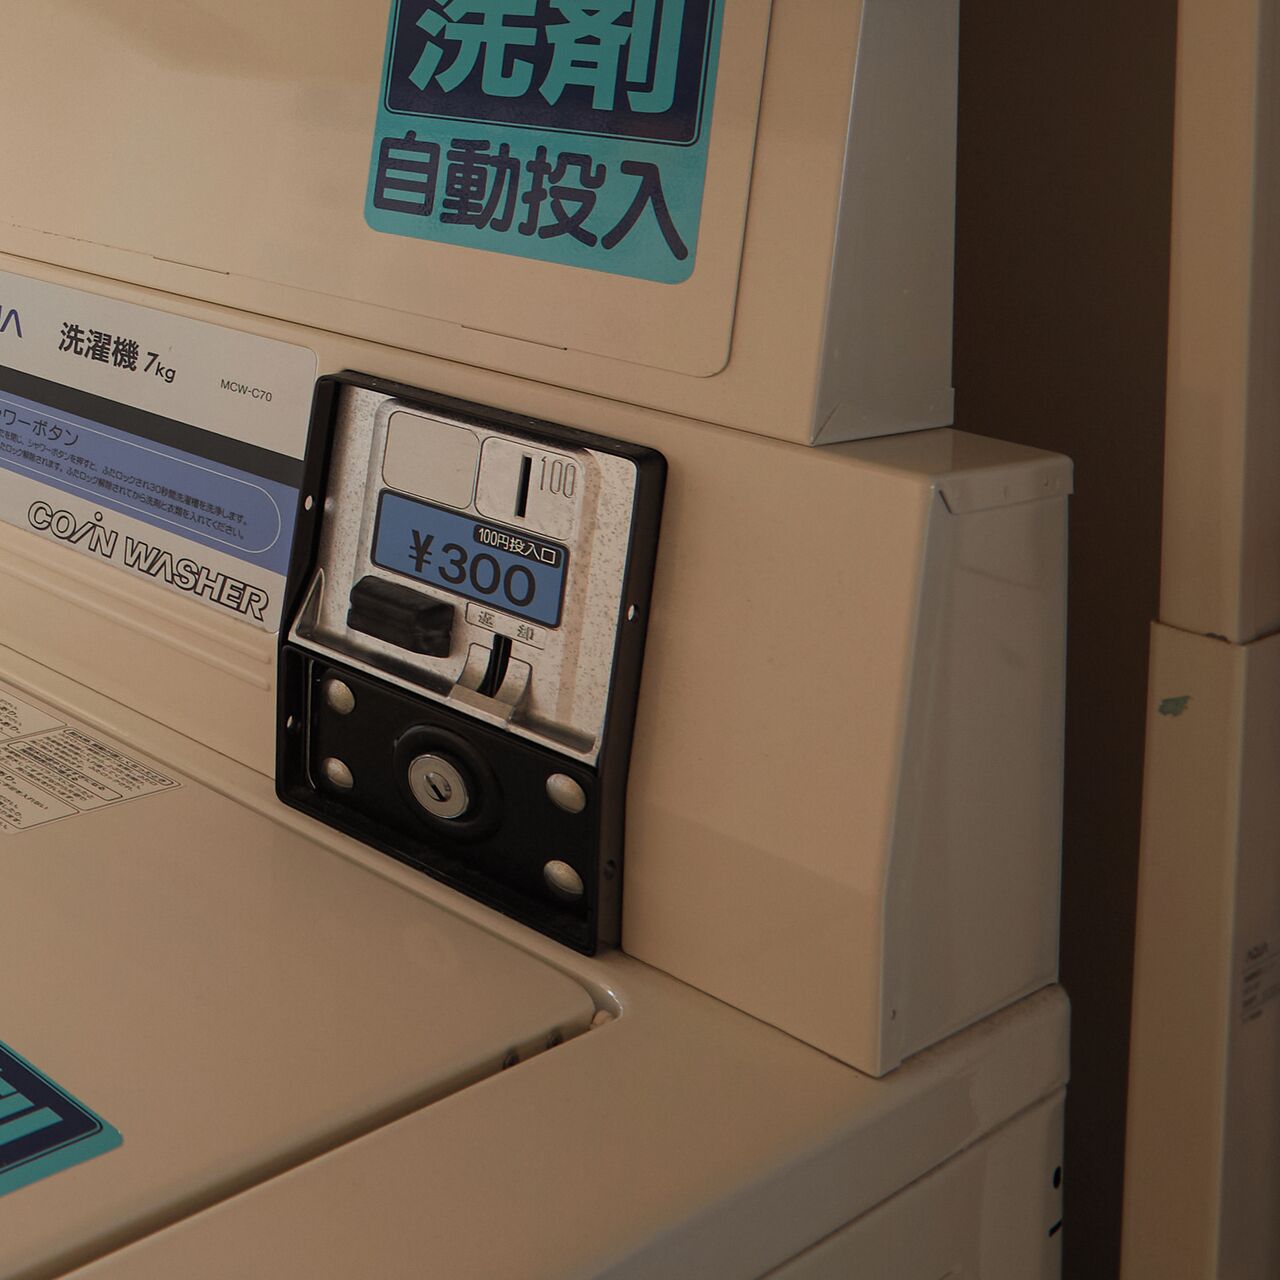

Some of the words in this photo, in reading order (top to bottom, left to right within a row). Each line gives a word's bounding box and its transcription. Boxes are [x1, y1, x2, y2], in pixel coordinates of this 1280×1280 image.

[372, 129, 689, 262] 自動投入
[57, 321, 140, 373] 洗濯機
[143, 350, 178, 384] 7kg
[220, 378, 274, 403] MCW-C70
[540, 455, 577, 499] 100
[27, 499, 119, 559] COIN
[123, 535, 270, 622] WASHER
[408, 528, 537, 608] ¥300
[477, 526, 557, 565] 100円投入口
